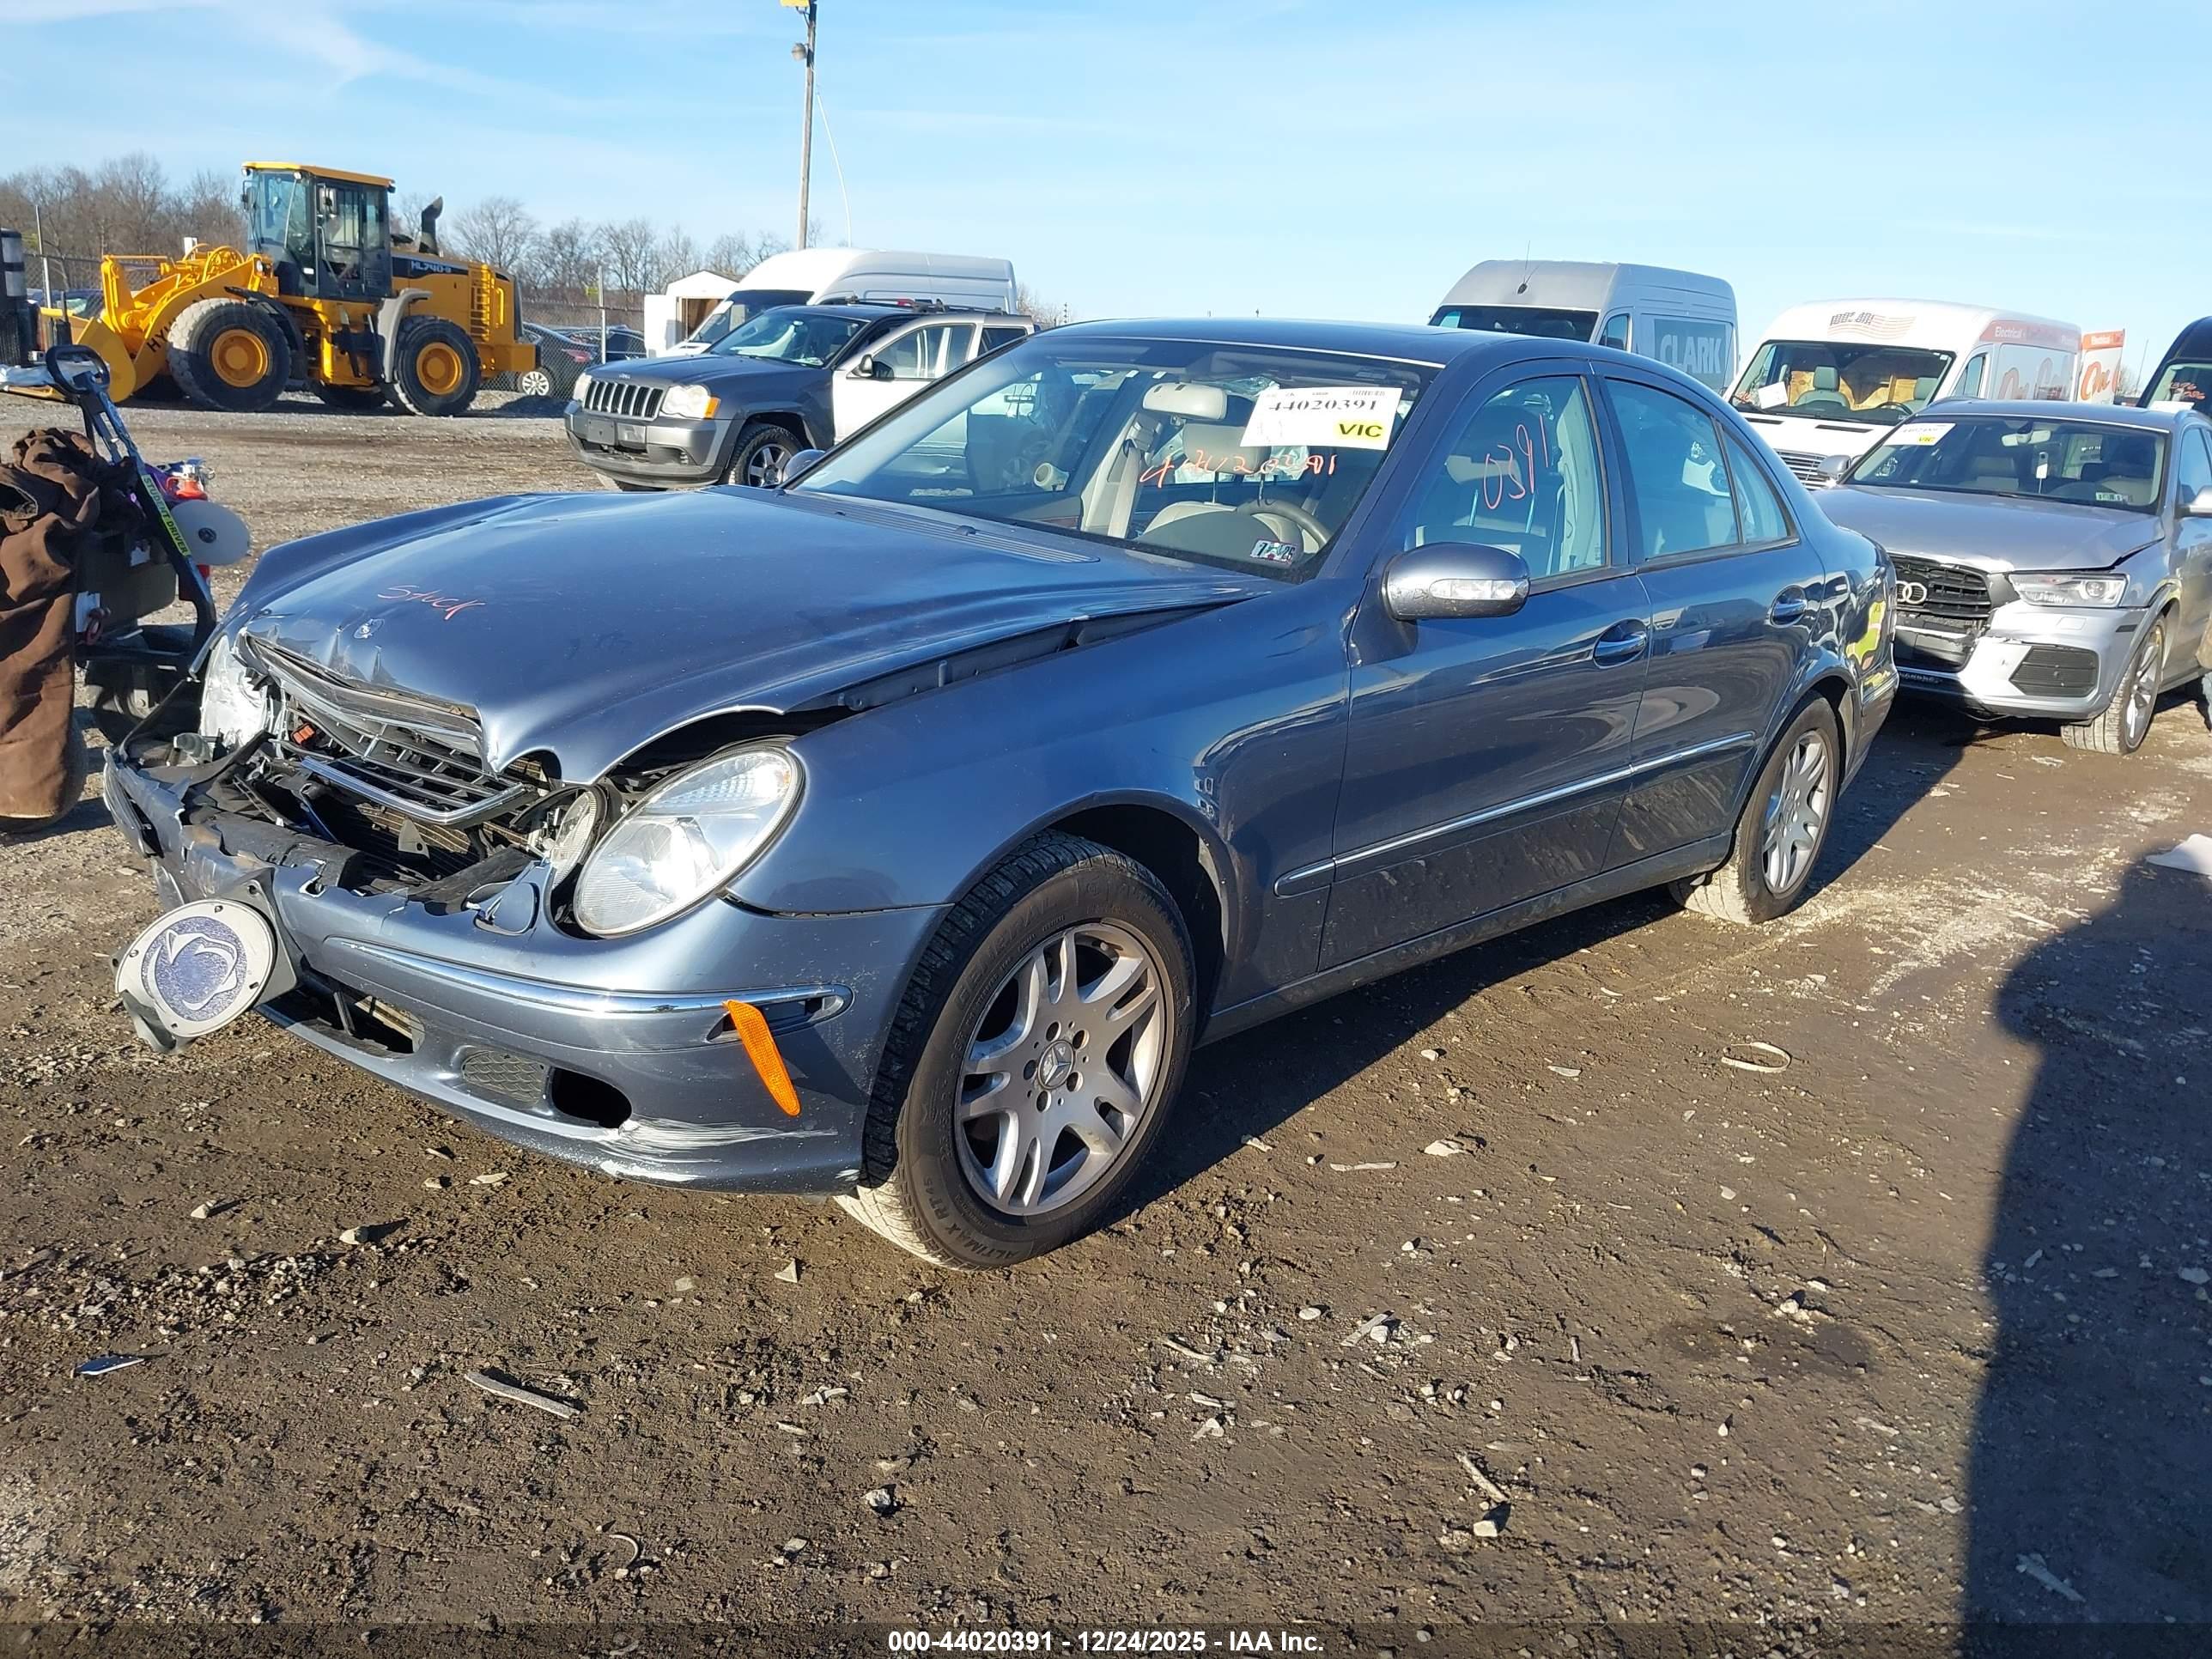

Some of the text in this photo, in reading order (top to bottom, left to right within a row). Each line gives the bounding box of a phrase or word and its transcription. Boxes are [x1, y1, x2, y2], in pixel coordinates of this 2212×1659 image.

[1659, 333, 1723, 374] CLARK
[1268, 399, 1377, 411] 44020391
[1339, 423, 1383, 438] VIC
[1484, 413, 1548, 509] 0391
[144, 477, 189, 553] STUDENT DRIVER
[945, 1222, 1018, 1260] ALTIMAX
